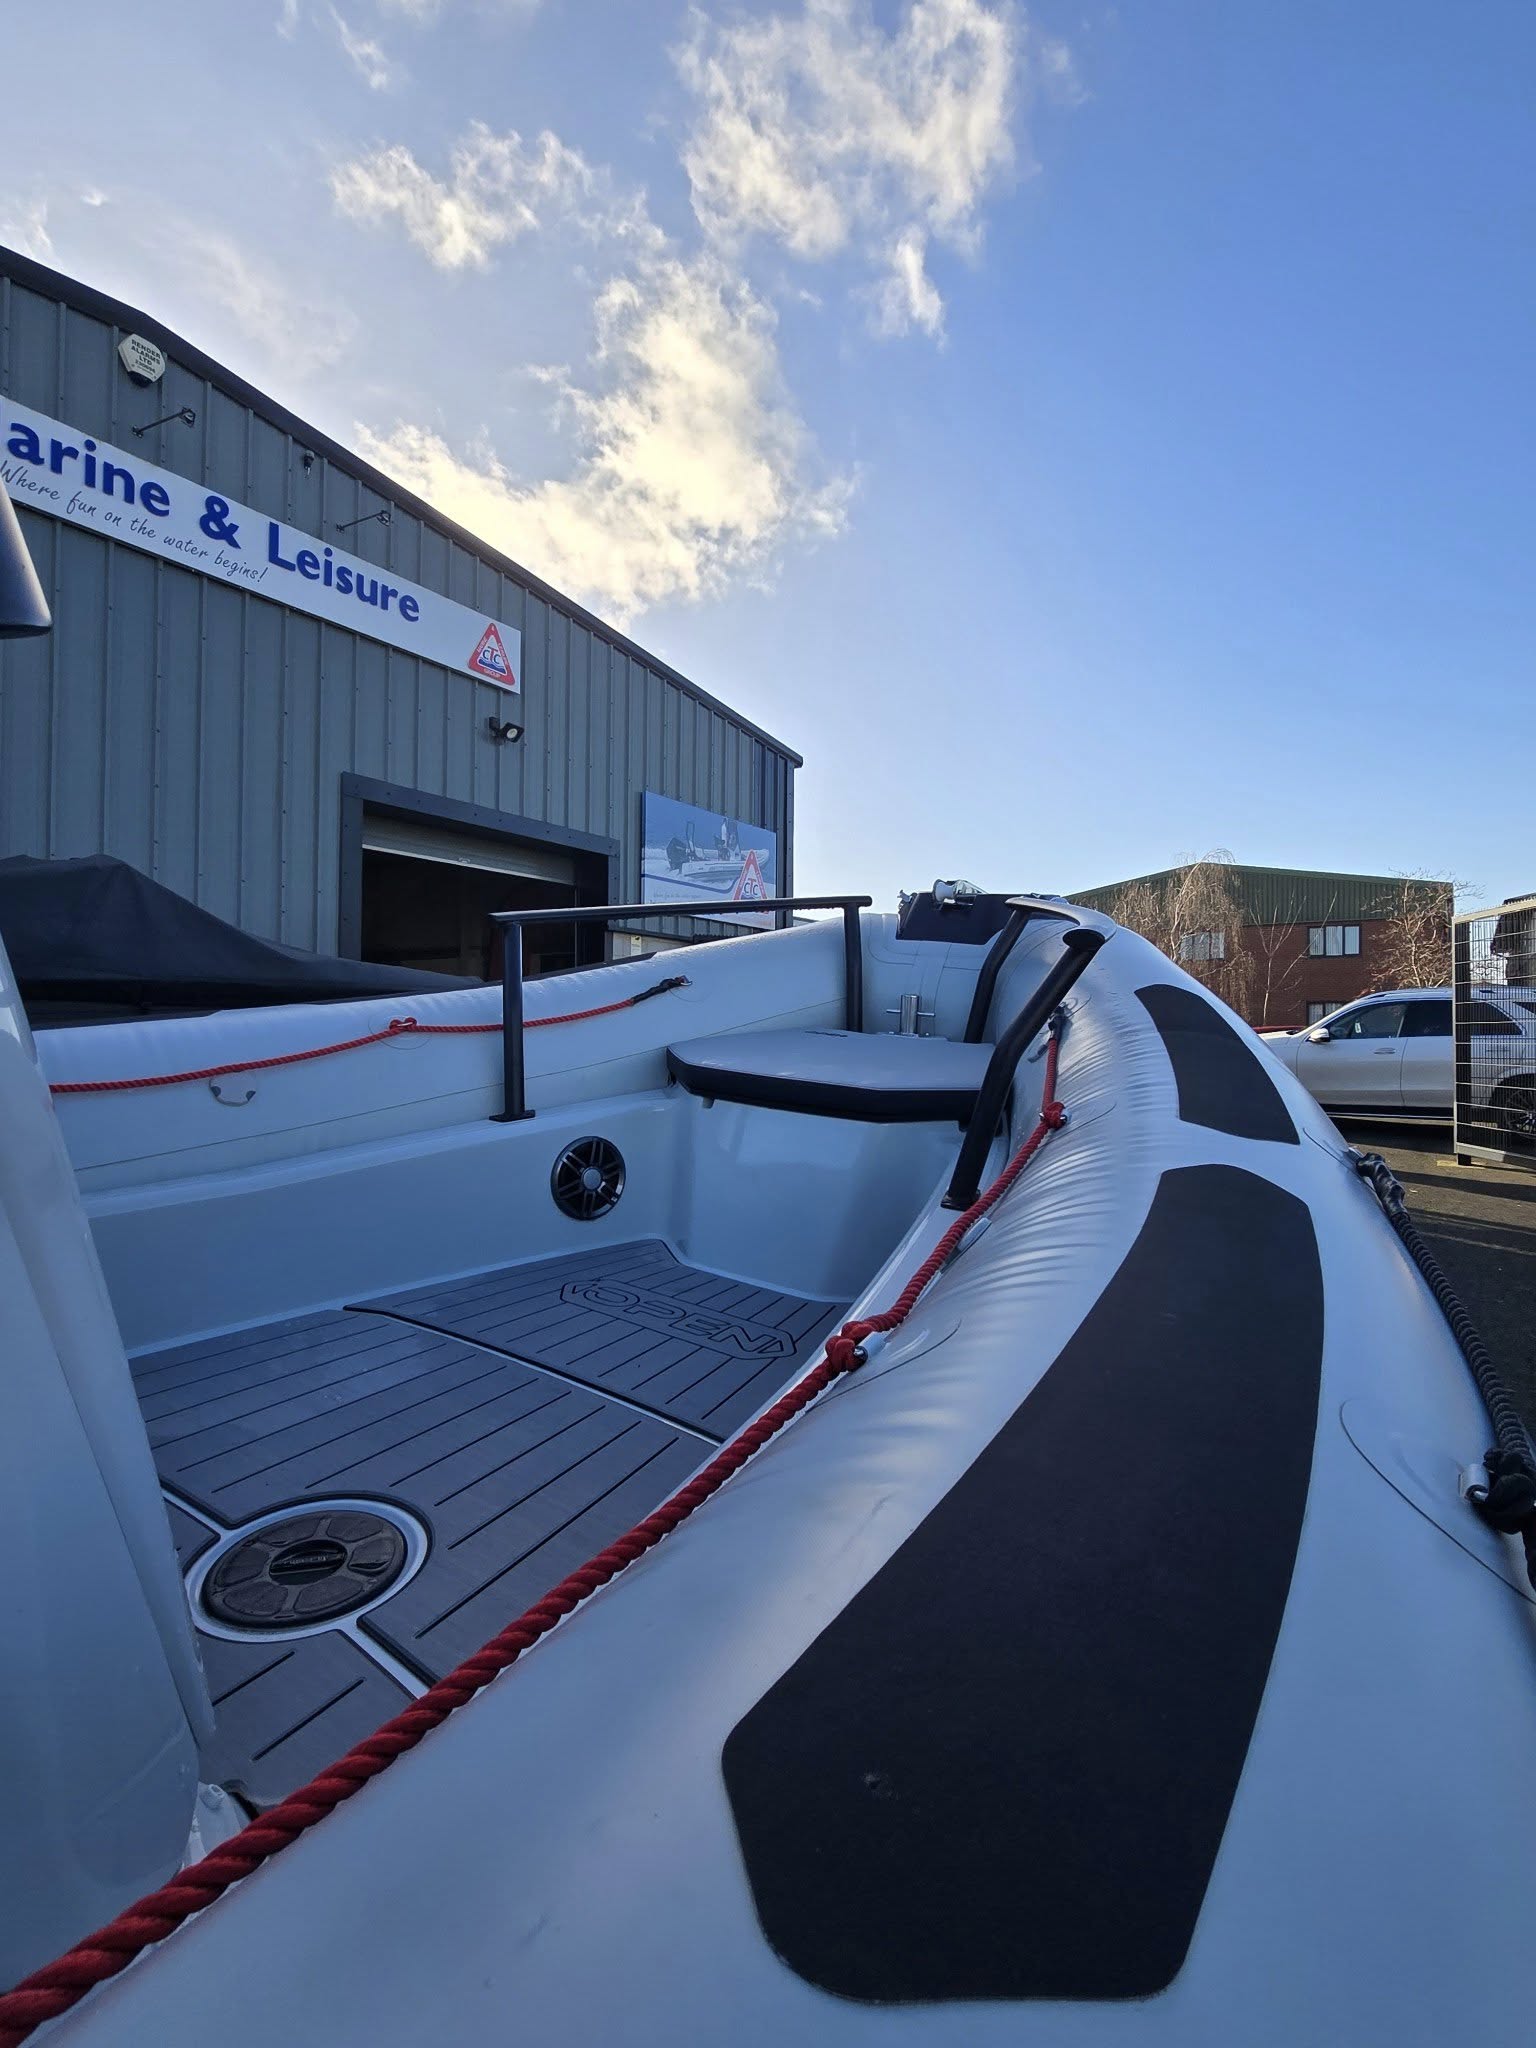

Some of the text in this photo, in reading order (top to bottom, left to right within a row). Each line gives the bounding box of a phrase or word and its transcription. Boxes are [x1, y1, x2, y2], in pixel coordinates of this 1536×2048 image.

[131, 339, 161, 359] RENDER
[131, 345, 161, 365] ALARMS
[138, 354, 153, 366] LTD
[0, 460, 269, 583] Where fun on the water begins!
[199, 495, 242, 549] &
[268, 521, 420, 622] Leisure
[482, 645, 501, 665] CTC
[743, 877, 759, 896] CTC
[583, 1286, 778, 1352] OPEN
